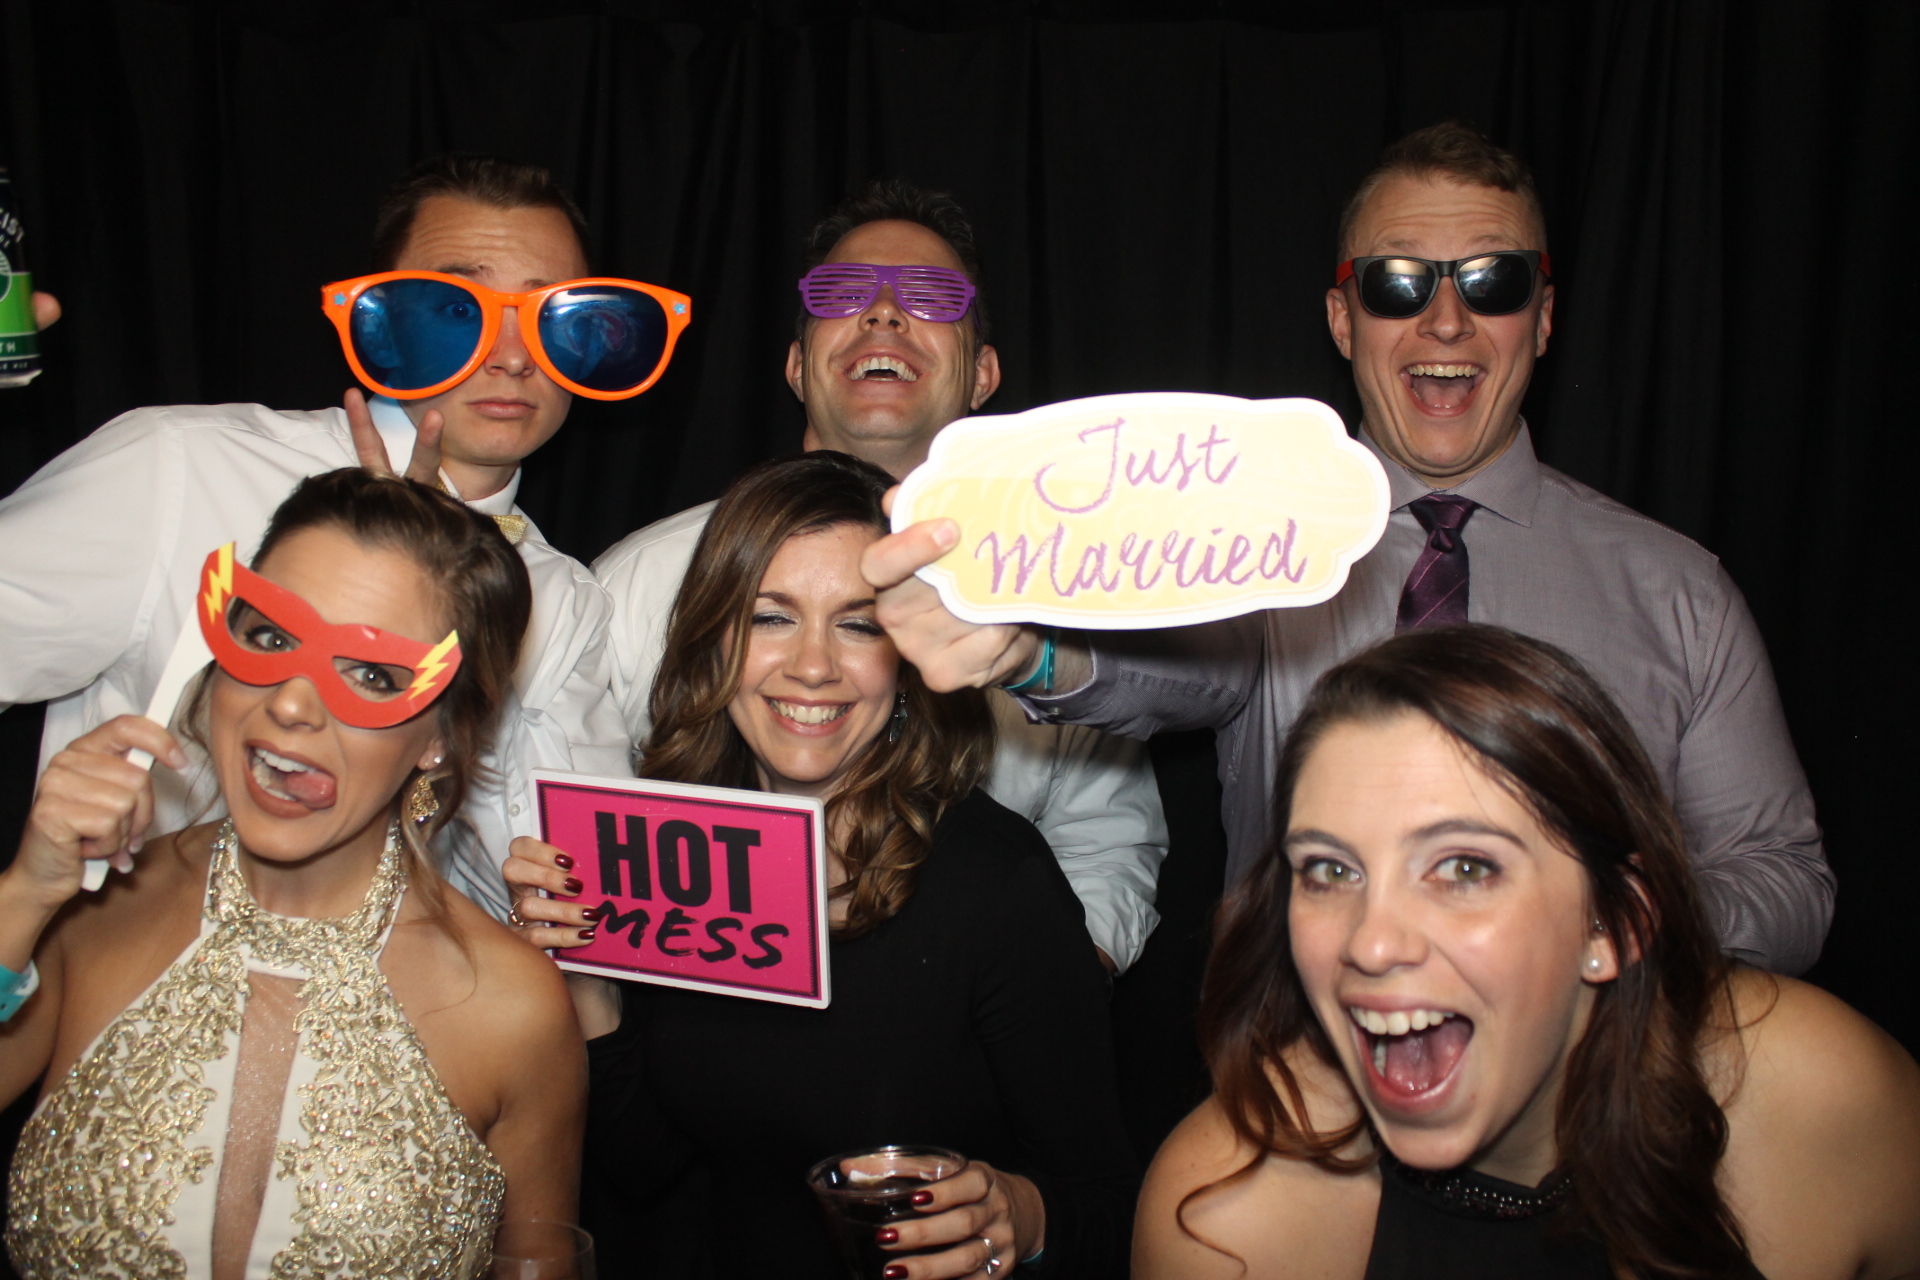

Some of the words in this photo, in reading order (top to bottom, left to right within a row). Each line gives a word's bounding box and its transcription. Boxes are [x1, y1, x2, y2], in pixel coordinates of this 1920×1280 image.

[1034, 416, 1241, 514] Just
[974, 518, 1308, 598] Married
[594, 810, 761, 915] HOT
[593, 900, 790, 970] MESS
